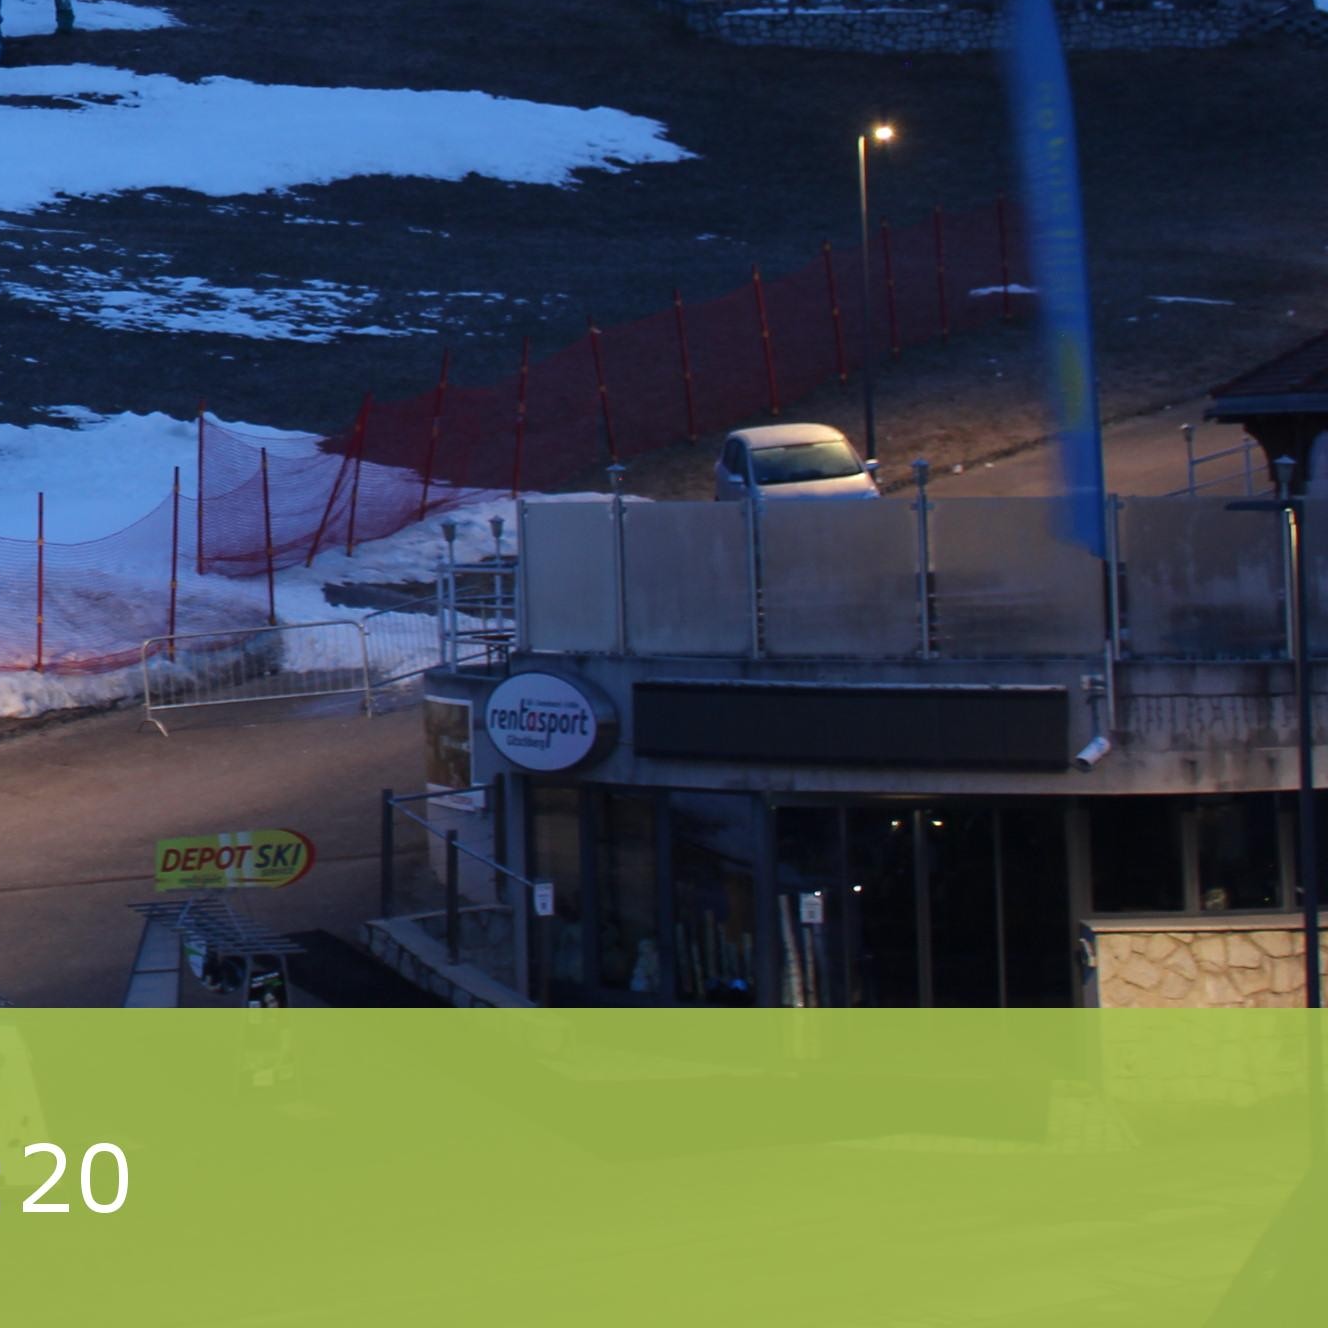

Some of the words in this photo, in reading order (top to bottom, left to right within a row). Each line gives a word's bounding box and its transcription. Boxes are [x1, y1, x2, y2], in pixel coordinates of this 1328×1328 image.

[489, 699, 589, 749] rentasport
[161, 845, 252, 872] DEPOT
[254, 842, 303, 869] SKI
